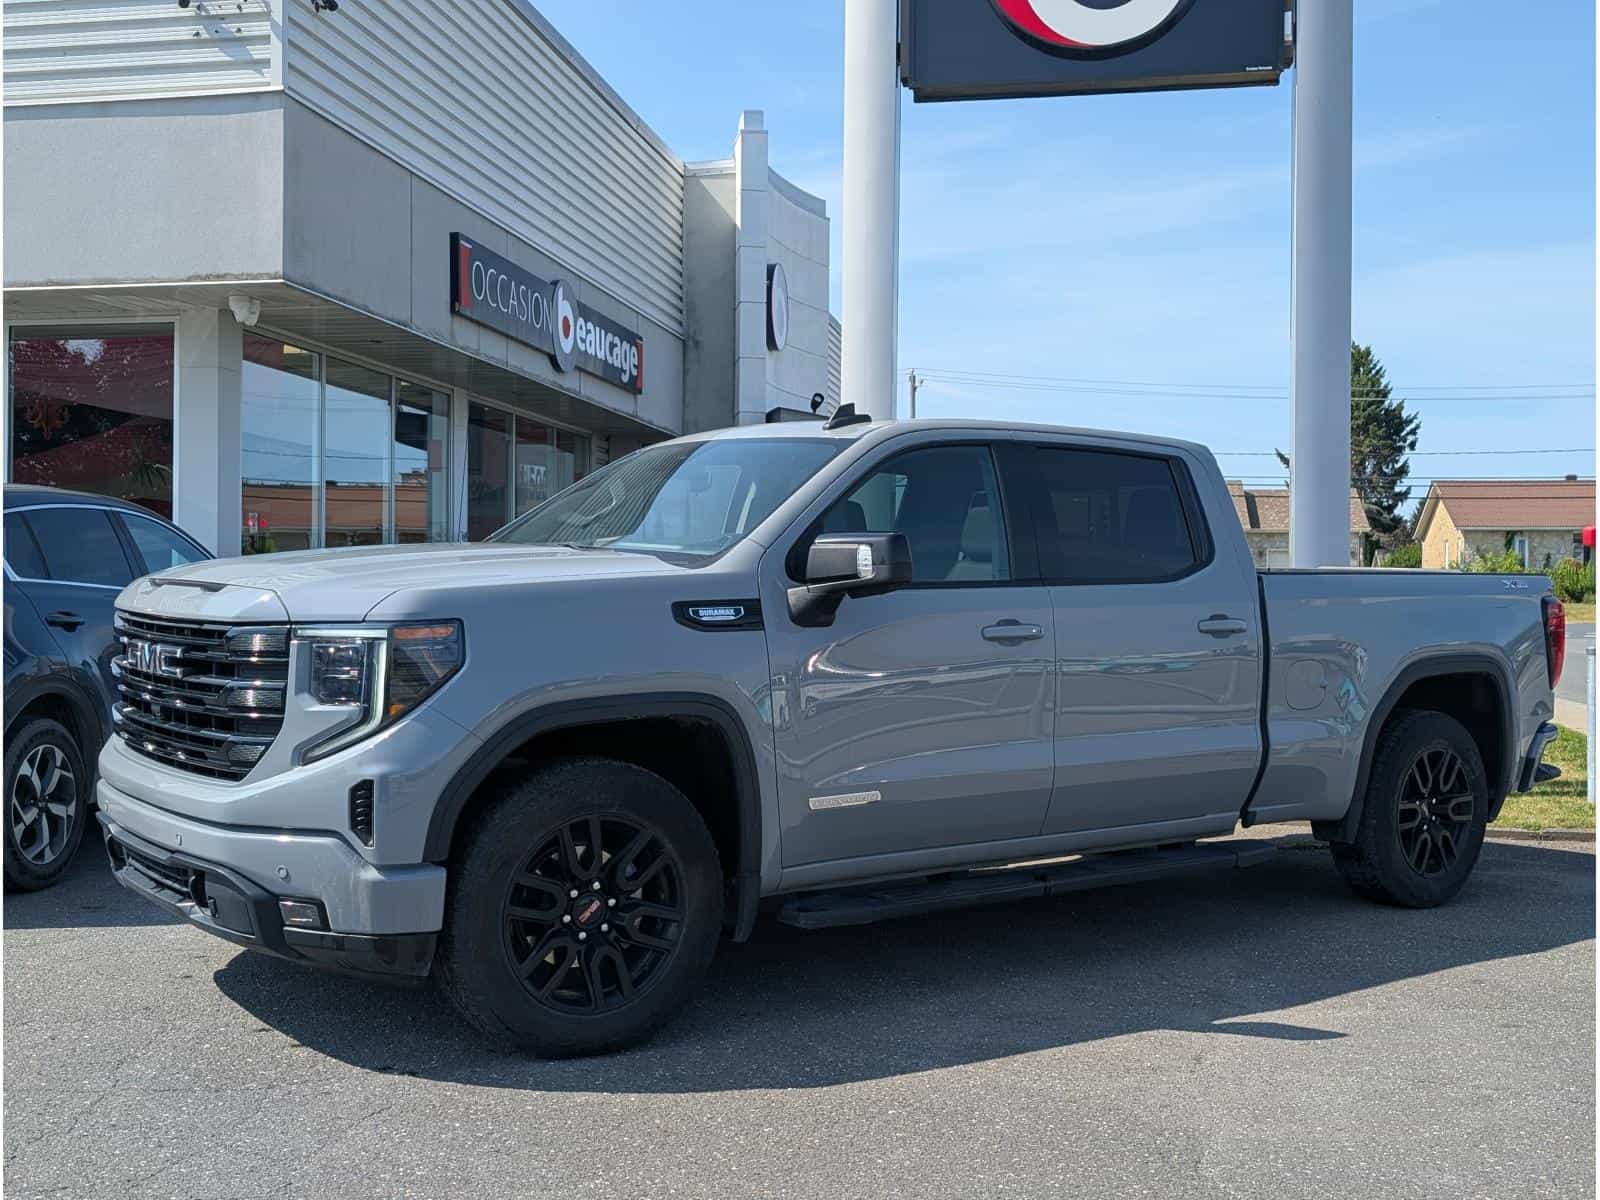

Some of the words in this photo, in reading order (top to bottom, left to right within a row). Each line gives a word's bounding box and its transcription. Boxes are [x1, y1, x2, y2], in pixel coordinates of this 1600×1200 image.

[471, 260, 553, 334] OCCASION
[557, 286, 639, 384] beaucage
[126, 641, 184, 679] GMC
